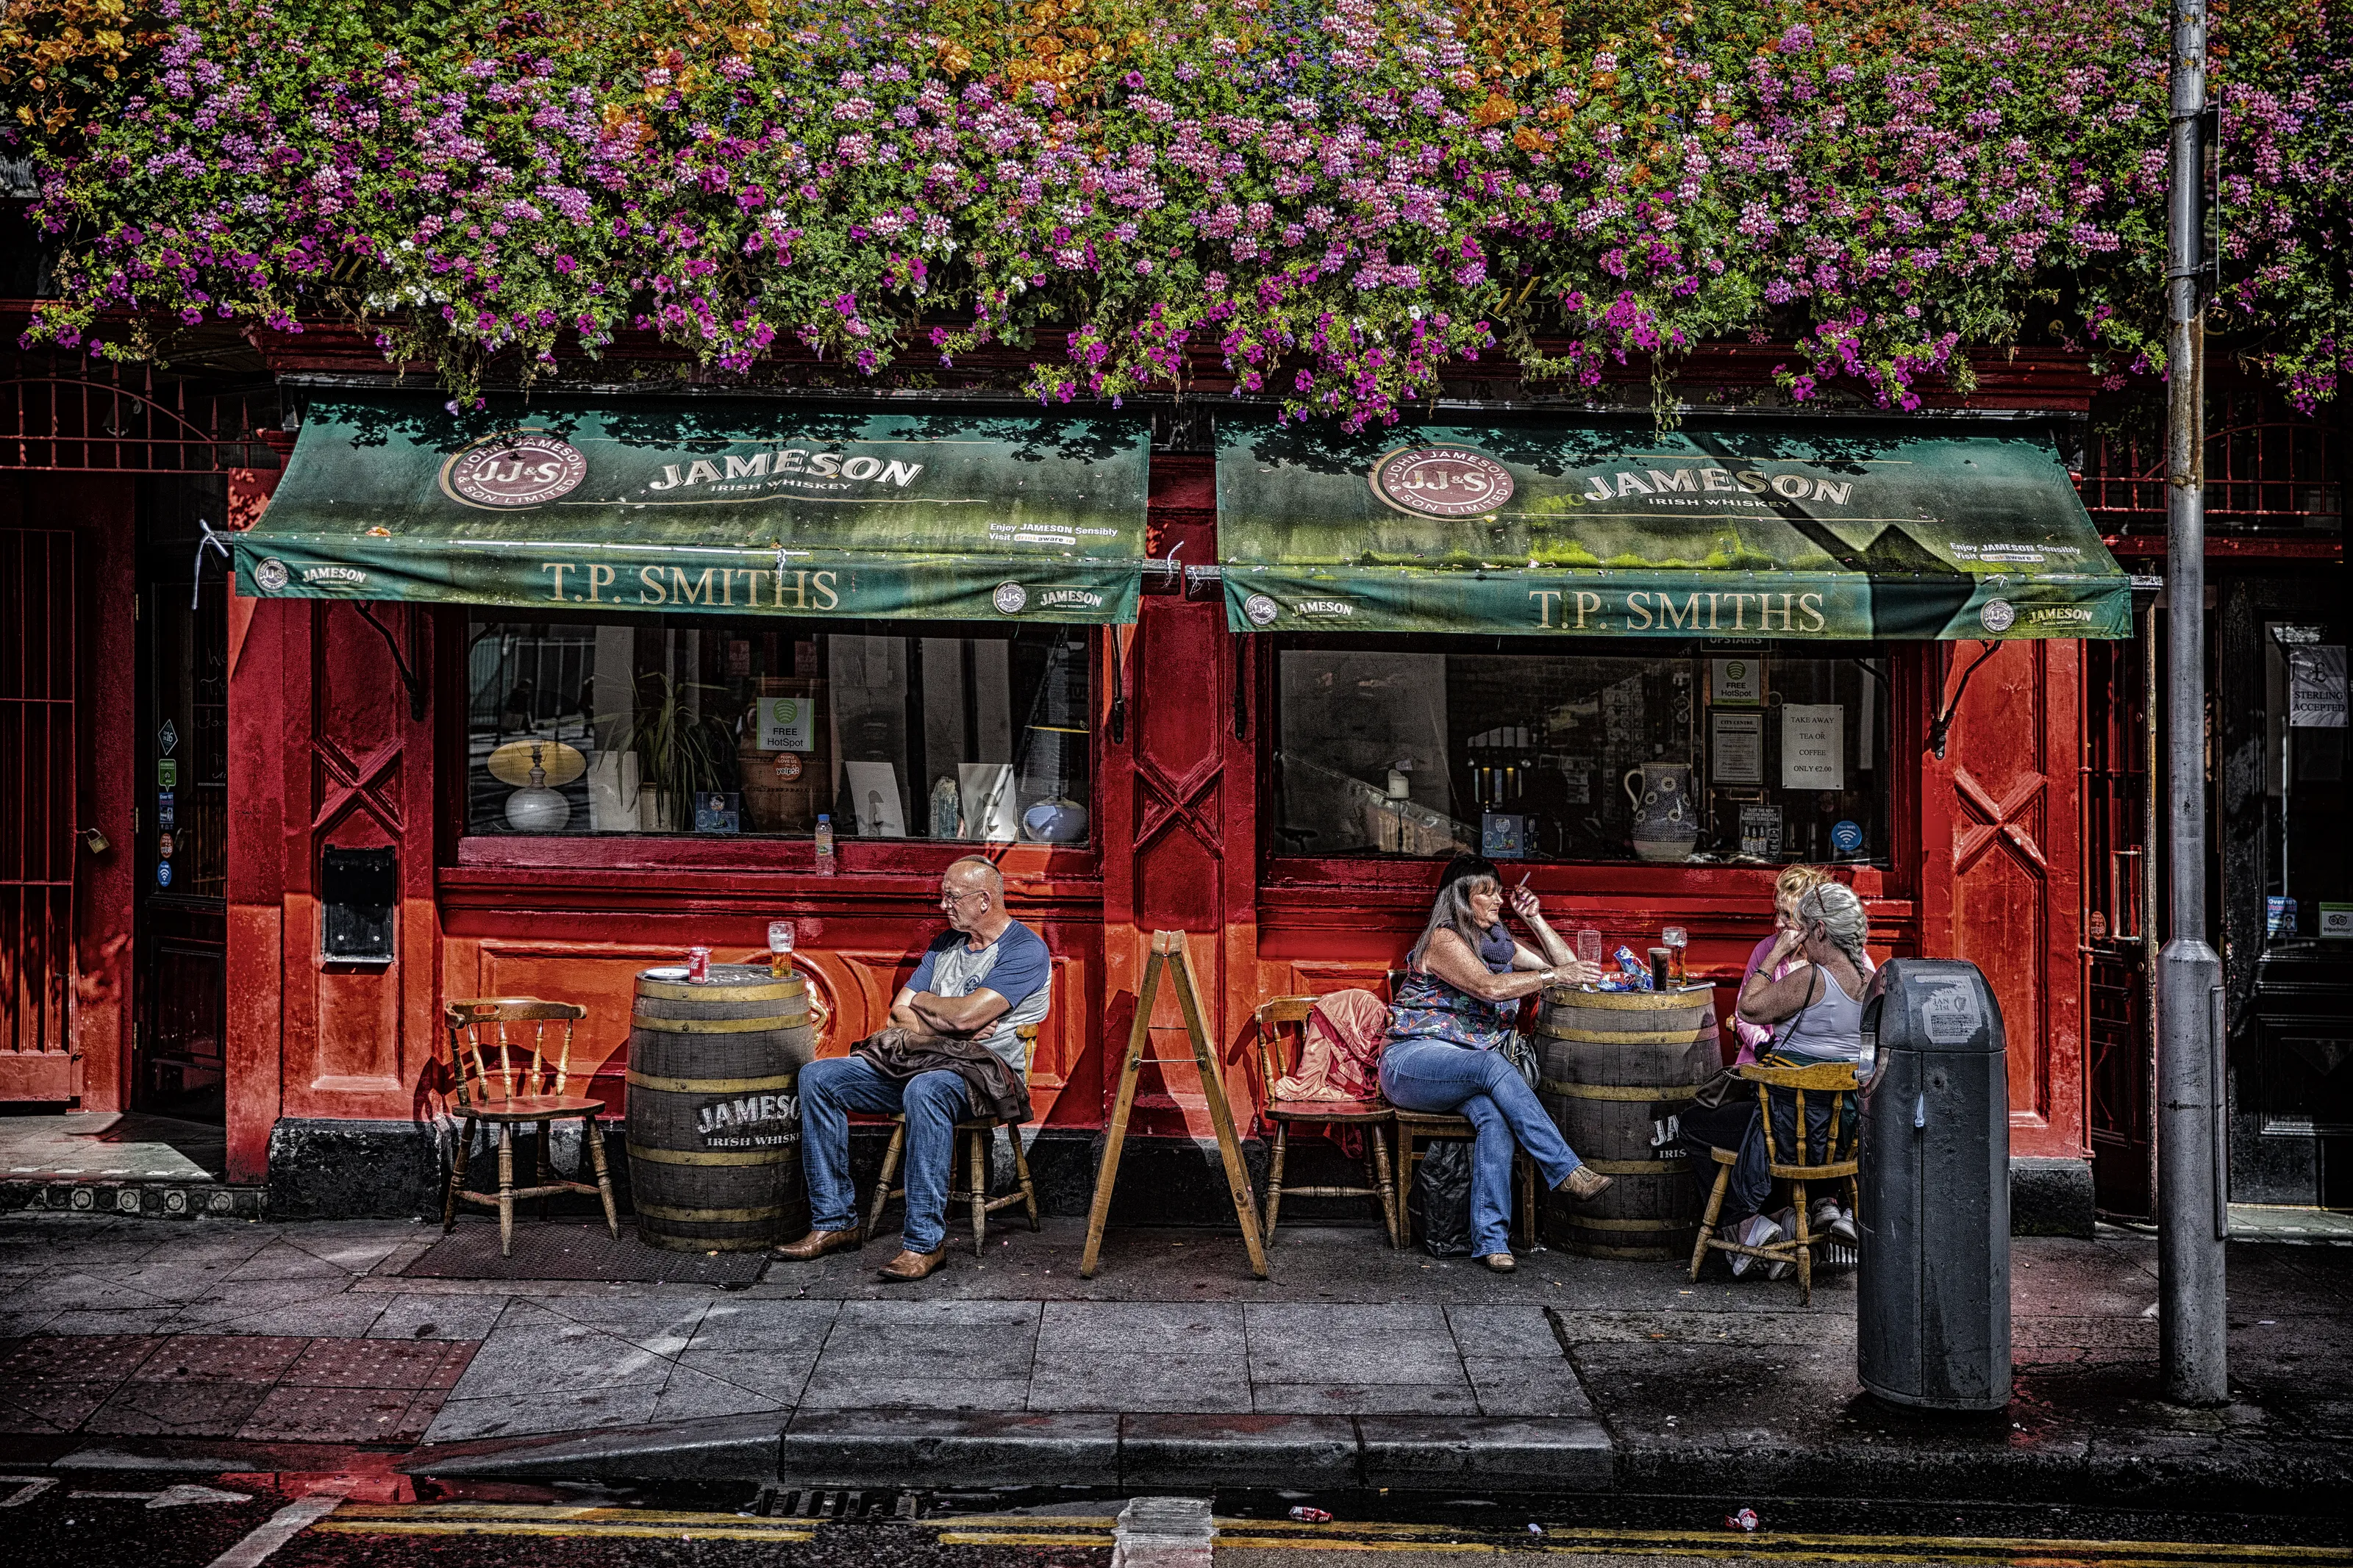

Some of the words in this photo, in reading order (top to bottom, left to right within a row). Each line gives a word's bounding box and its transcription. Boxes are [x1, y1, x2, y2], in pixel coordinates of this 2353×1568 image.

[464, 442, 505, 469] JOHN
[513, 437, 583, 471] JAMESON
[472, 461, 562, 483] JJ&S
[649, 449, 924, 491] JAMESON
[1388, 453, 1423, 478] JOHN
[1429, 451, 1508, 480] JAMESON
[711, 484, 761, 492] IRISH
[767, 479, 853, 492] WHISKEY
[1402, 470, 1488, 493] JJ&S
[1584, 468, 1853, 505] JAMESON
[464, 485, 498, 502] SON
[504, 479, 577, 504] LIMITED
[1401, 494, 1438, 512] SON
[1448, 489, 1508, 513] LIMITED
[1649, 497, 1700, 505] IRISH
[1704, 498, 1790, 508] WHISKEY
[990, 523, 1018, 533] Enjoy
[1019, 523, 1072, 534] JAMESON
[1075, 526, 1118, 537] Sensibly
[989, 533, 1011, 541] Visit
[1015, 535, 1074, 544] drinkawareie
[1949, 543, 1977, 552] Enjoy
[1982, 543, 2035, 552] JAMESON
[2036, 544, 2081, 555] Sensibly
[1953, 551, 1978, 559] Visit
[303, 568, 367, 584] JAMESON
[543, 563, 622, 603] T.P.
[640, 565, 839, 611] SMITHS
[1040, 590, 1103, 607] JAMESON
[1292, 601, 1354, 617] JAMESON
[1529, 591, 1608, 629] T.P.
[1627, 591, 1826, 632] SMITHS
[2029, 608, 2093, 624] JAMESON
[2310, 662, 2327, 683] £
[1721, 690, 1752, 698] HotSpot
[2294, 691, 2343, 700] STERLING
[2293, 703, 2346, 712] ACCEPTED
[773, 728, 798, 736] FREE
[768, 738, 804, 748] HotSpot
[776, 767, 793, 776] yelp
[697, 1095, 801, 1134] JAMESO
[707, 1137, 750, 1146] IRISH
[754, 1132, 801, 1145] WHISKE
[1659, 1149, 1687, 1159] IRIS
